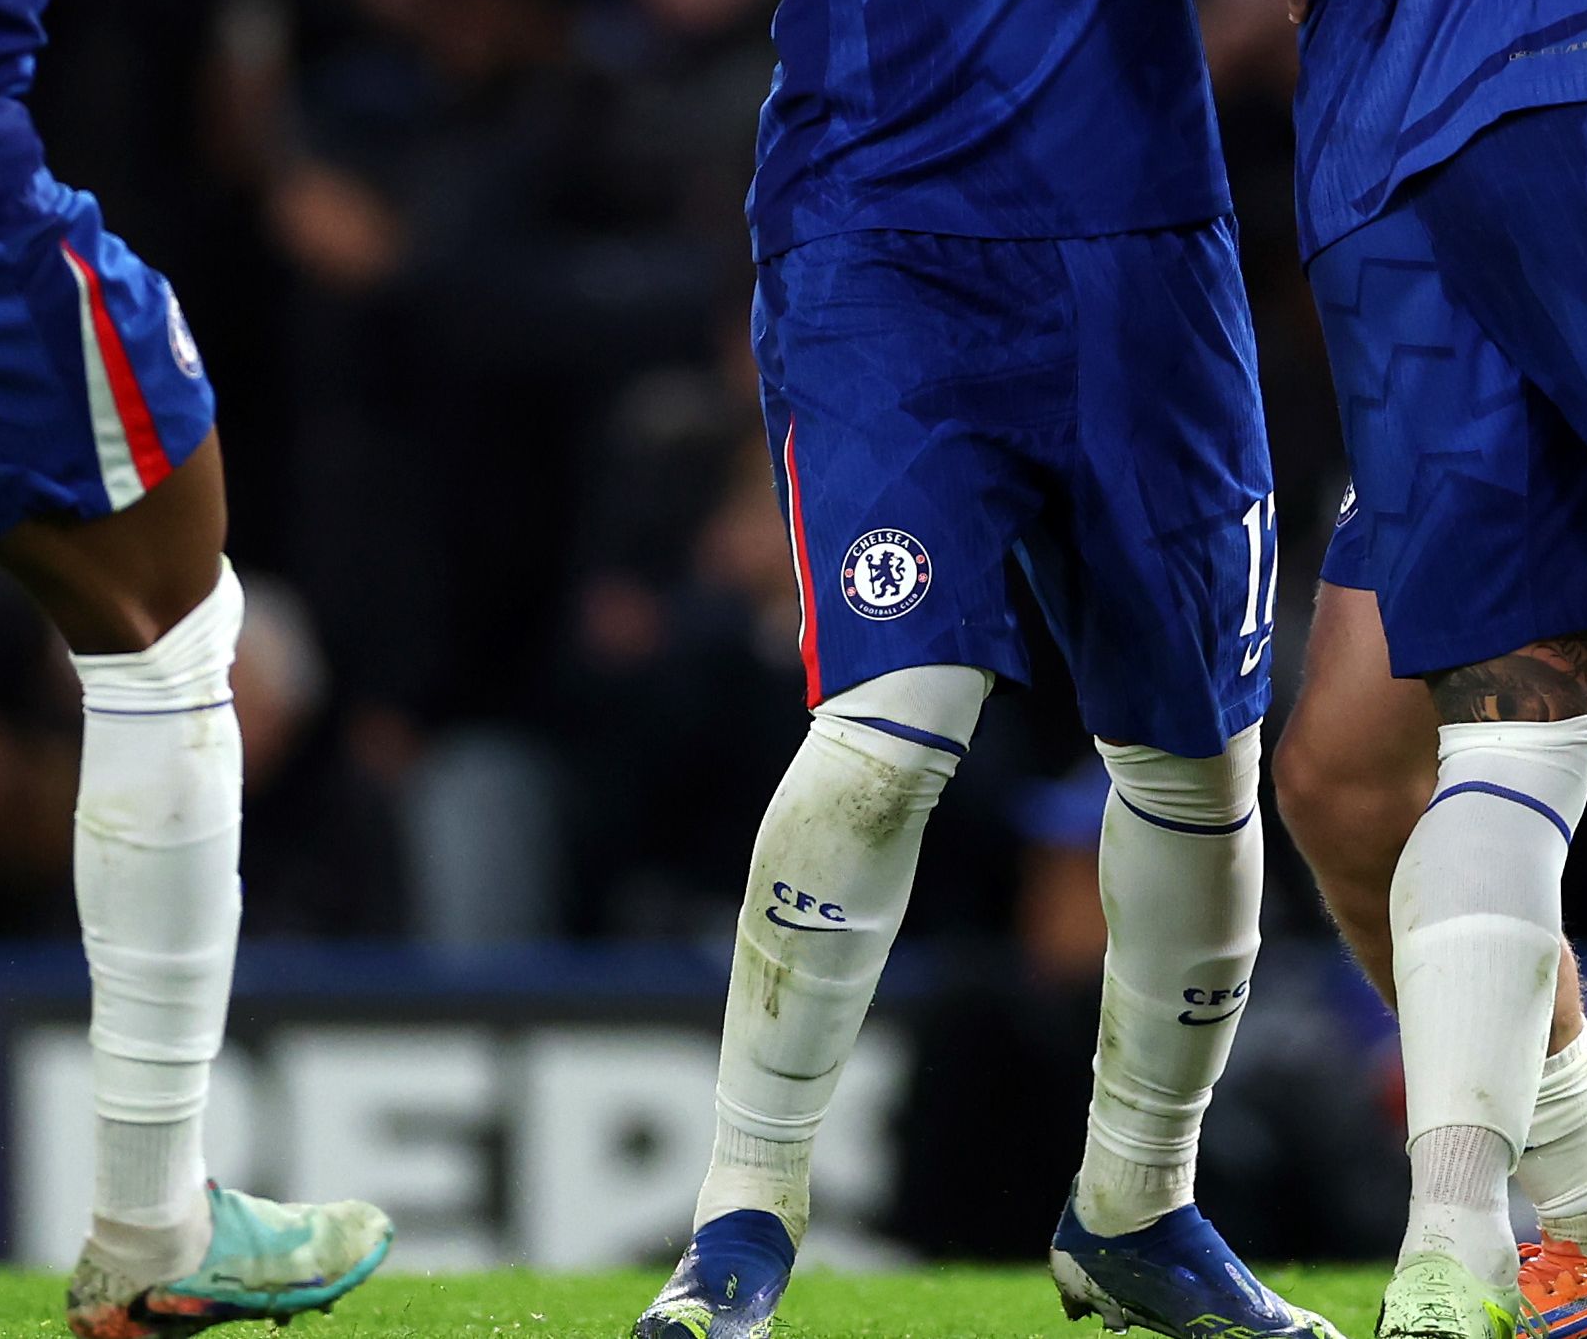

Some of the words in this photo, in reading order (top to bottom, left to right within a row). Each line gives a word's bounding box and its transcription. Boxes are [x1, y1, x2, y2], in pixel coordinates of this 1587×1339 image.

[852, 532, 910, 557] CHELSEA
[859, 603, 897, 615] FOOTBALL
[899, 593, 918, 609] CLUB
[772, 881, 847, 922] CFC
[1182, 980, 1248, 1006] CFC
